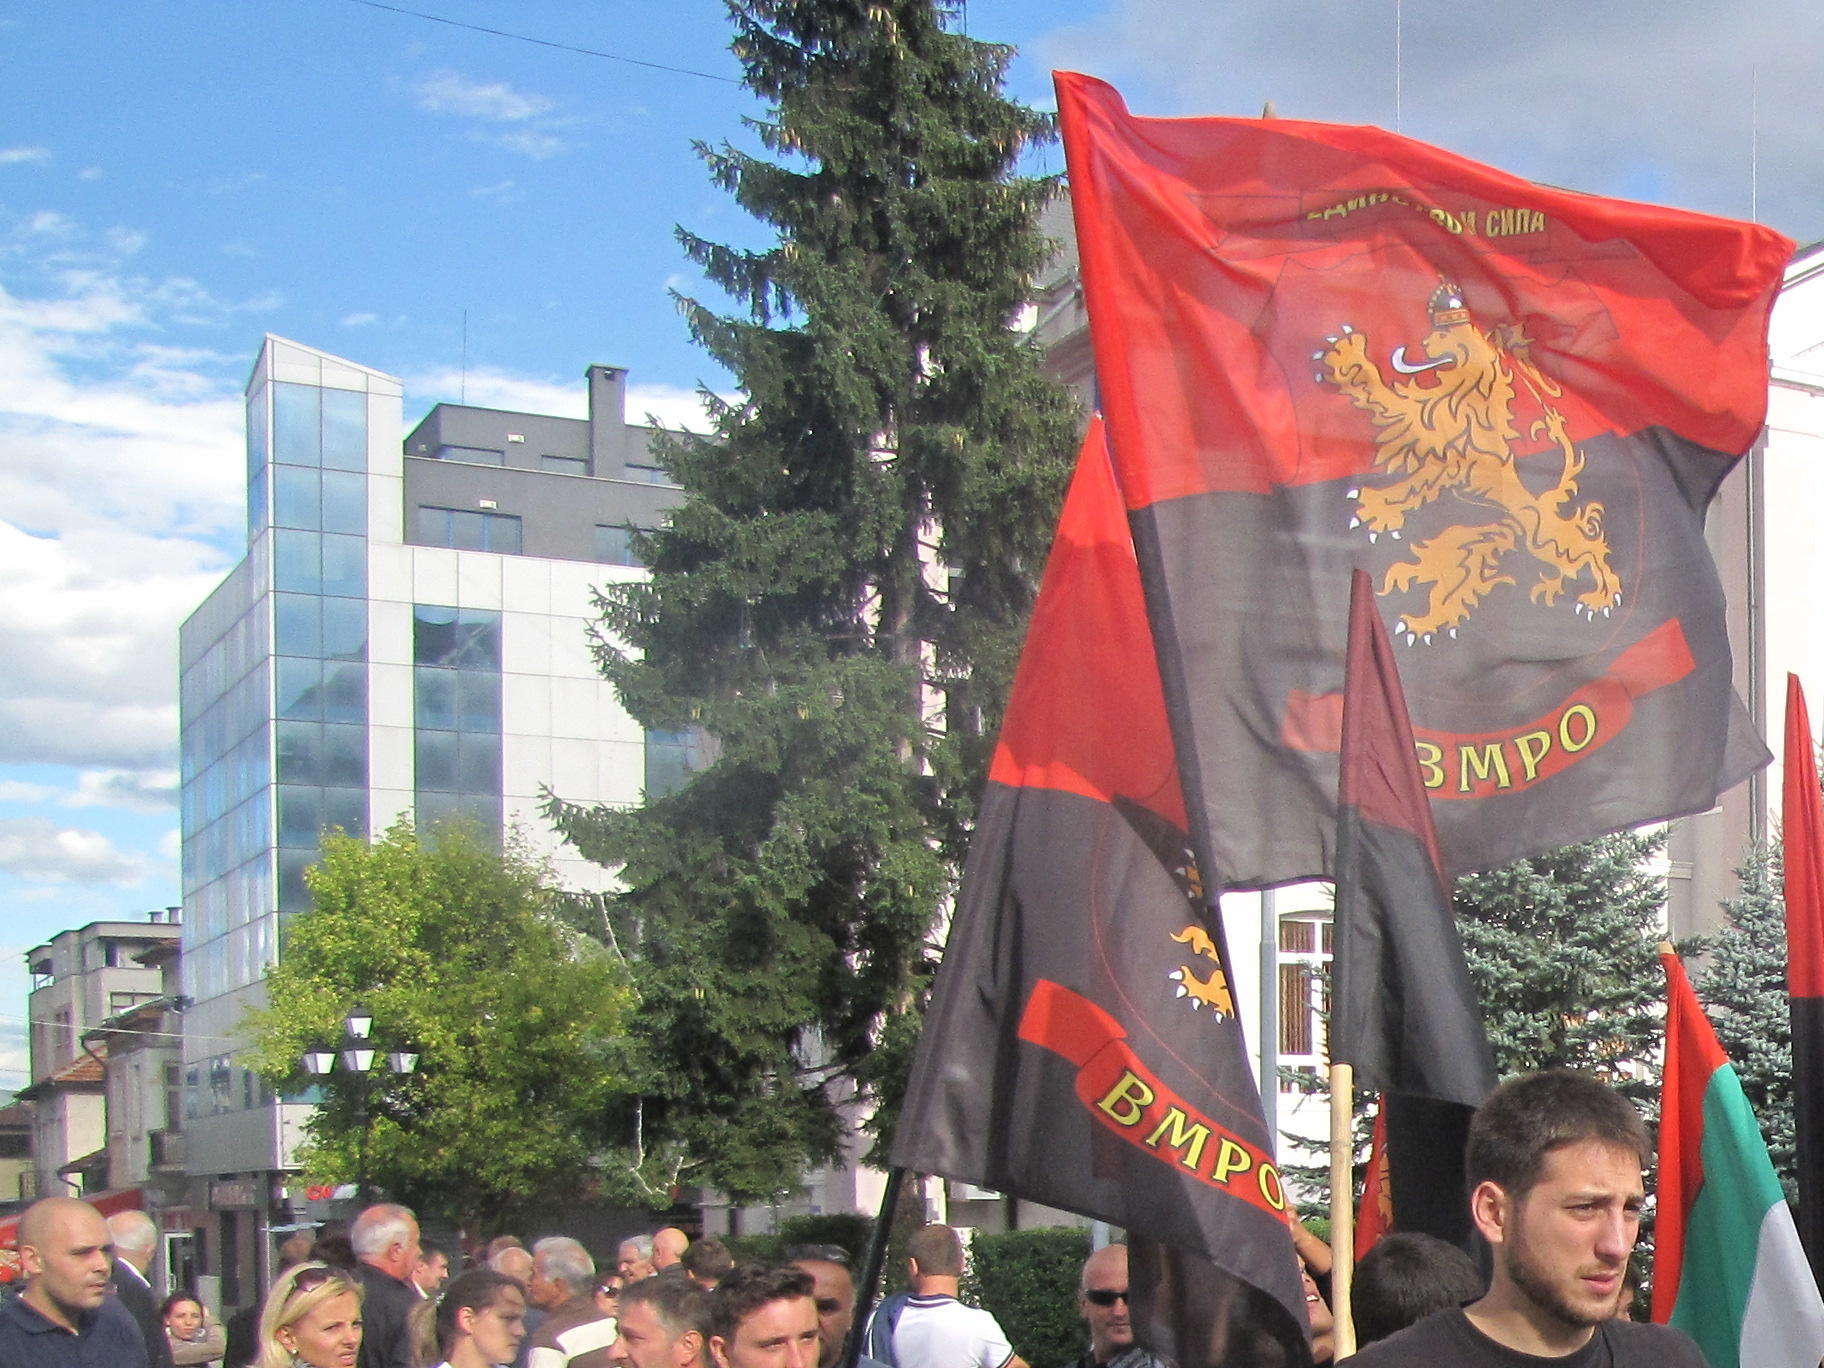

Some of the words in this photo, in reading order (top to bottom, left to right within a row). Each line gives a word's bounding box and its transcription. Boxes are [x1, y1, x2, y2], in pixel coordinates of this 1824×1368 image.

[1485, 208, 1546, 238] СИЛА
[1415, 705, 1597, 791] ВМРО
[1097, 1069, 1286, 1211] ВМРО
